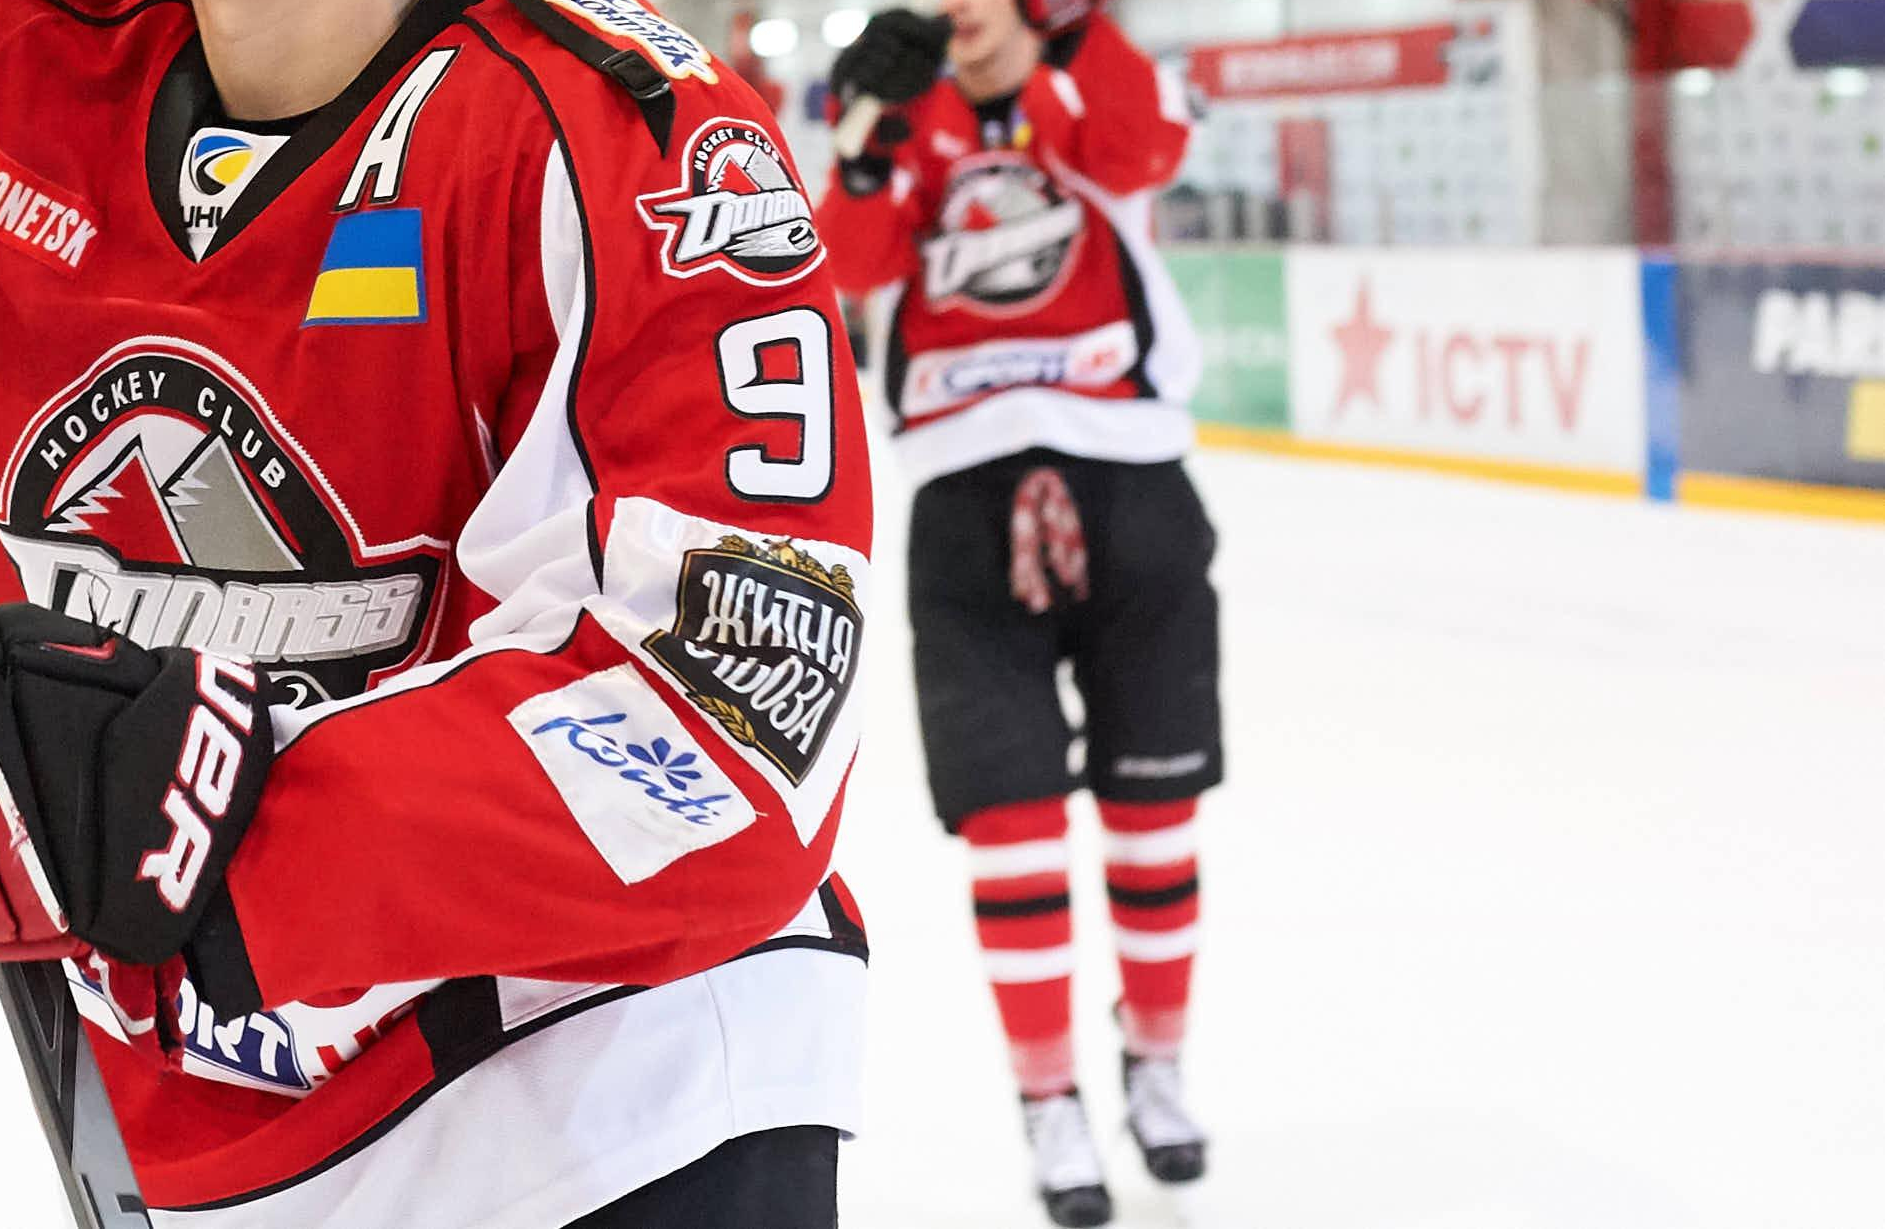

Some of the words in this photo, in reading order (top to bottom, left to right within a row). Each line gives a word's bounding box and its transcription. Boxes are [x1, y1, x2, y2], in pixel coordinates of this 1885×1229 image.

[335, 46, 461, 211] A
[694, 128, 735, 172] HOCKEY
[40, 370, 166, 471] HOCKEY
[197, 386, 287, 489] CLUB
[716, 307, 835, 503] 9
[1415, 329, 1591, 434] ICTV
[695, 569, 855, 685] ЖИТНЯ
